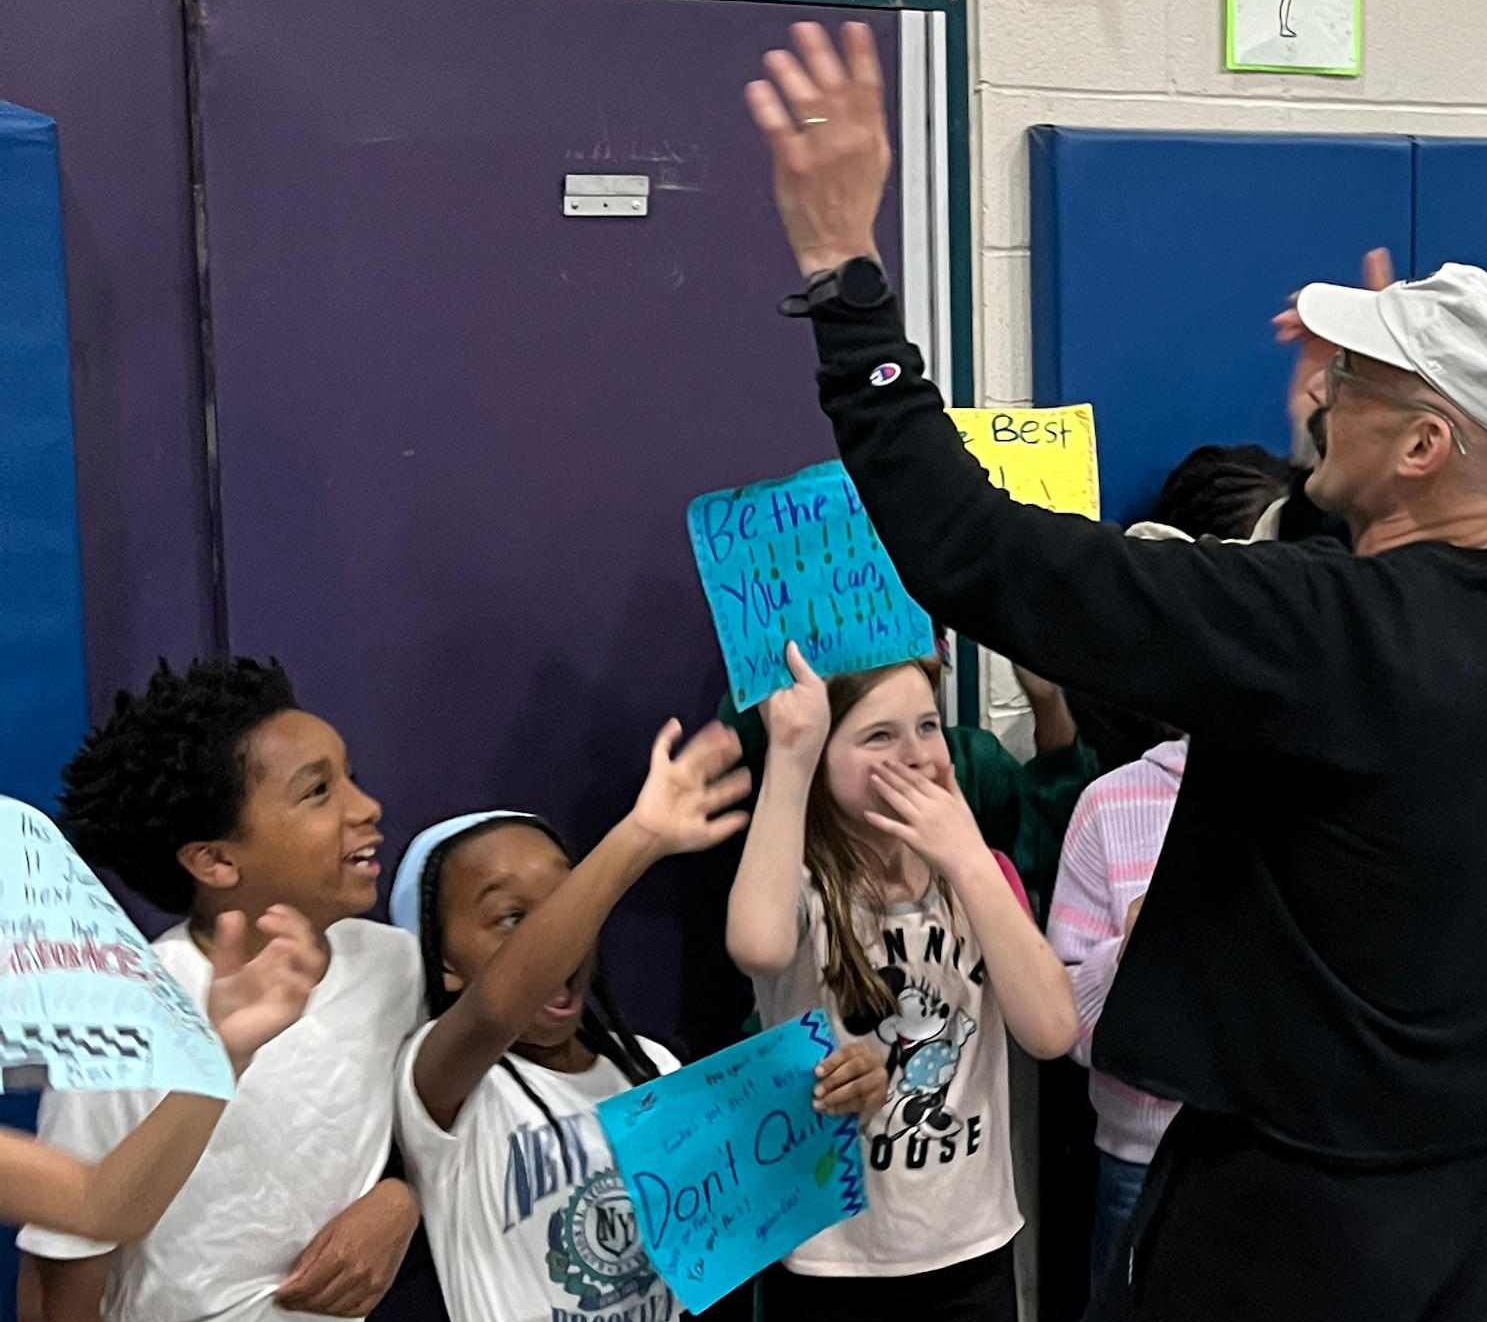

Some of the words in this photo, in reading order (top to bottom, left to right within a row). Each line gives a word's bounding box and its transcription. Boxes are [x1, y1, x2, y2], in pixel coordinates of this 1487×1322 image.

[991, 413, 1072, 449] Best
[703, 495, 758, 564] Be
[766, 491, 827, 534] the
[870, 1115, 981, 1171] OUSE
[631, 1139, 739, 1251] Don't
